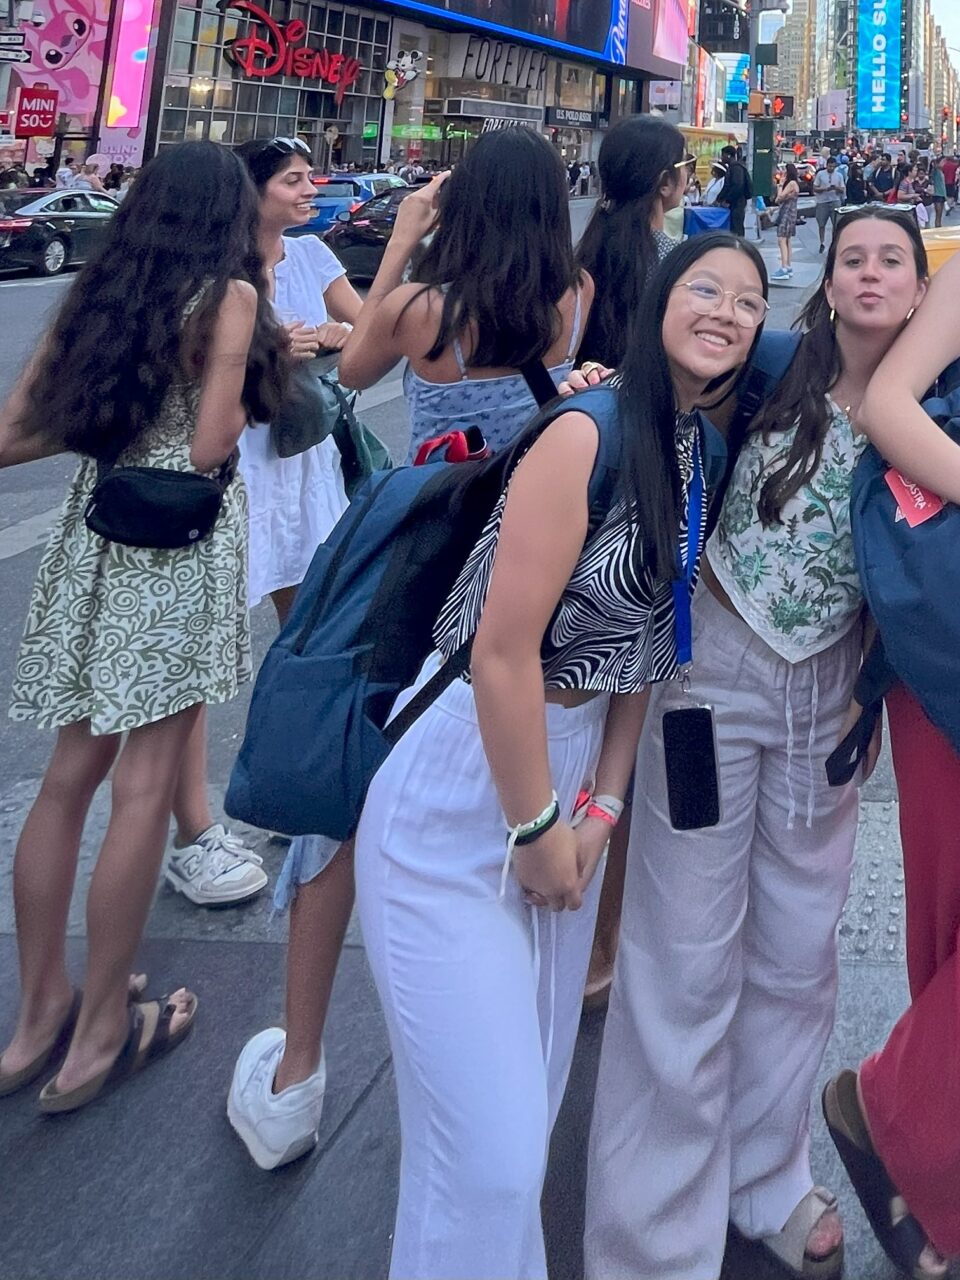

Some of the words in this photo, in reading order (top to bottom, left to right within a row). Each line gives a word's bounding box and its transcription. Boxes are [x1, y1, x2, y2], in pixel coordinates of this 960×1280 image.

[461, 35, 548, 91] FOREVER
[872, 33, 887, 113] HELLO
[22, 97, 55, 112] MINI
[566, 110, 579, 120] POLO
[908, 483, 927, 510] ASTRA
